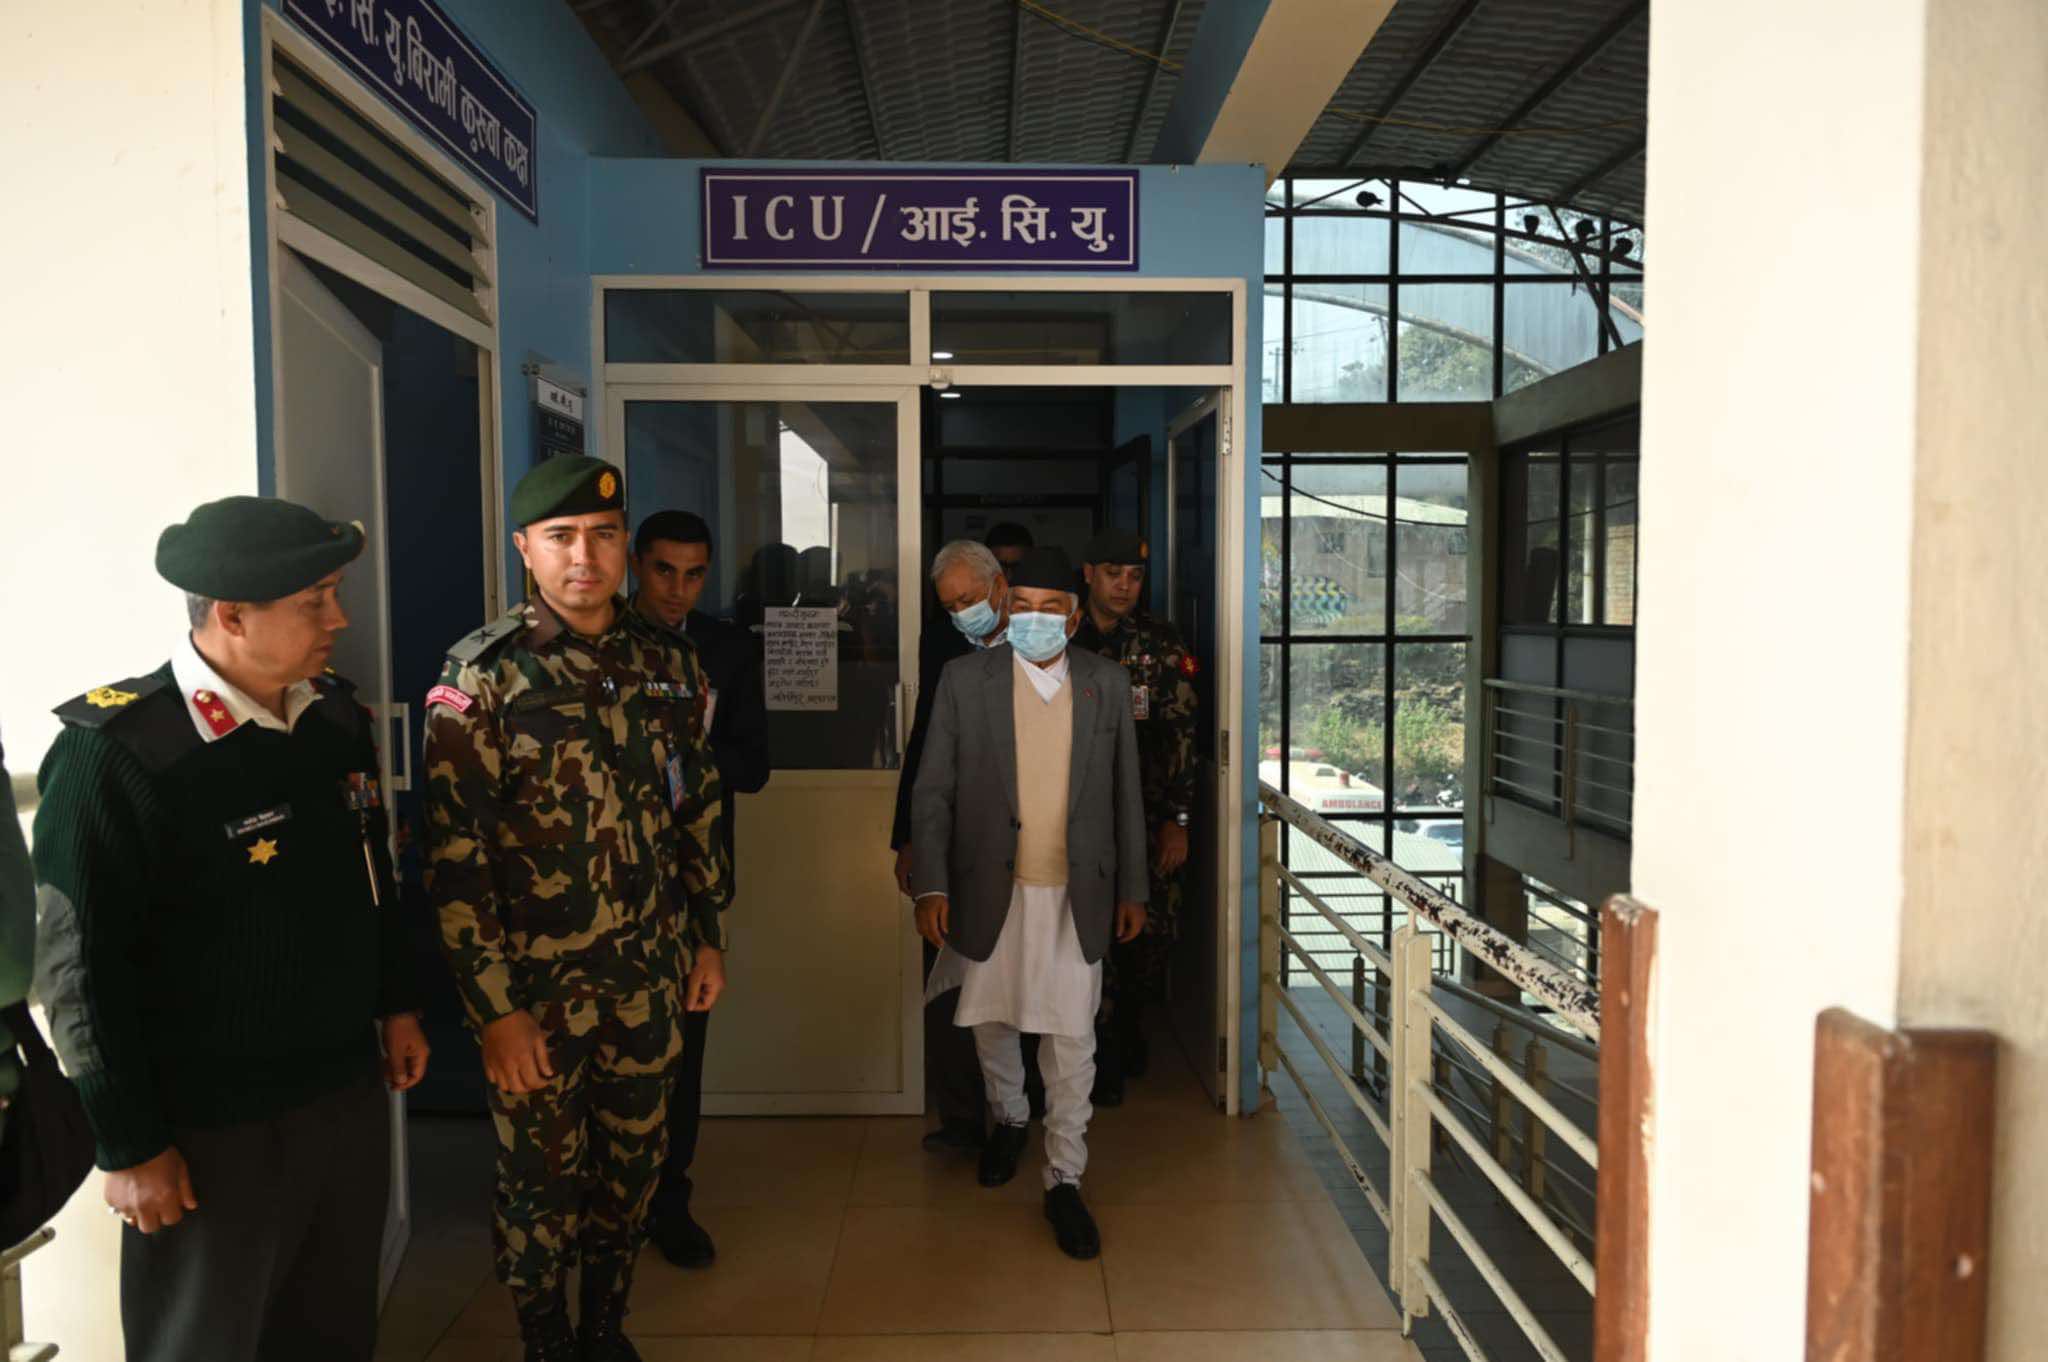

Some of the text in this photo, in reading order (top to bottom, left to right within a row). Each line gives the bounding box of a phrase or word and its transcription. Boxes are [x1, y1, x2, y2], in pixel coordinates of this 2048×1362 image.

[406, 15, 457, 121] बिरामी
[900, 197, 987, 247] आई.
[1001, 194, 1058, 244] सि.
[1071, 206, 1116, 253] यु.
[1321, 799, 1383, 809] AMBULANCE
